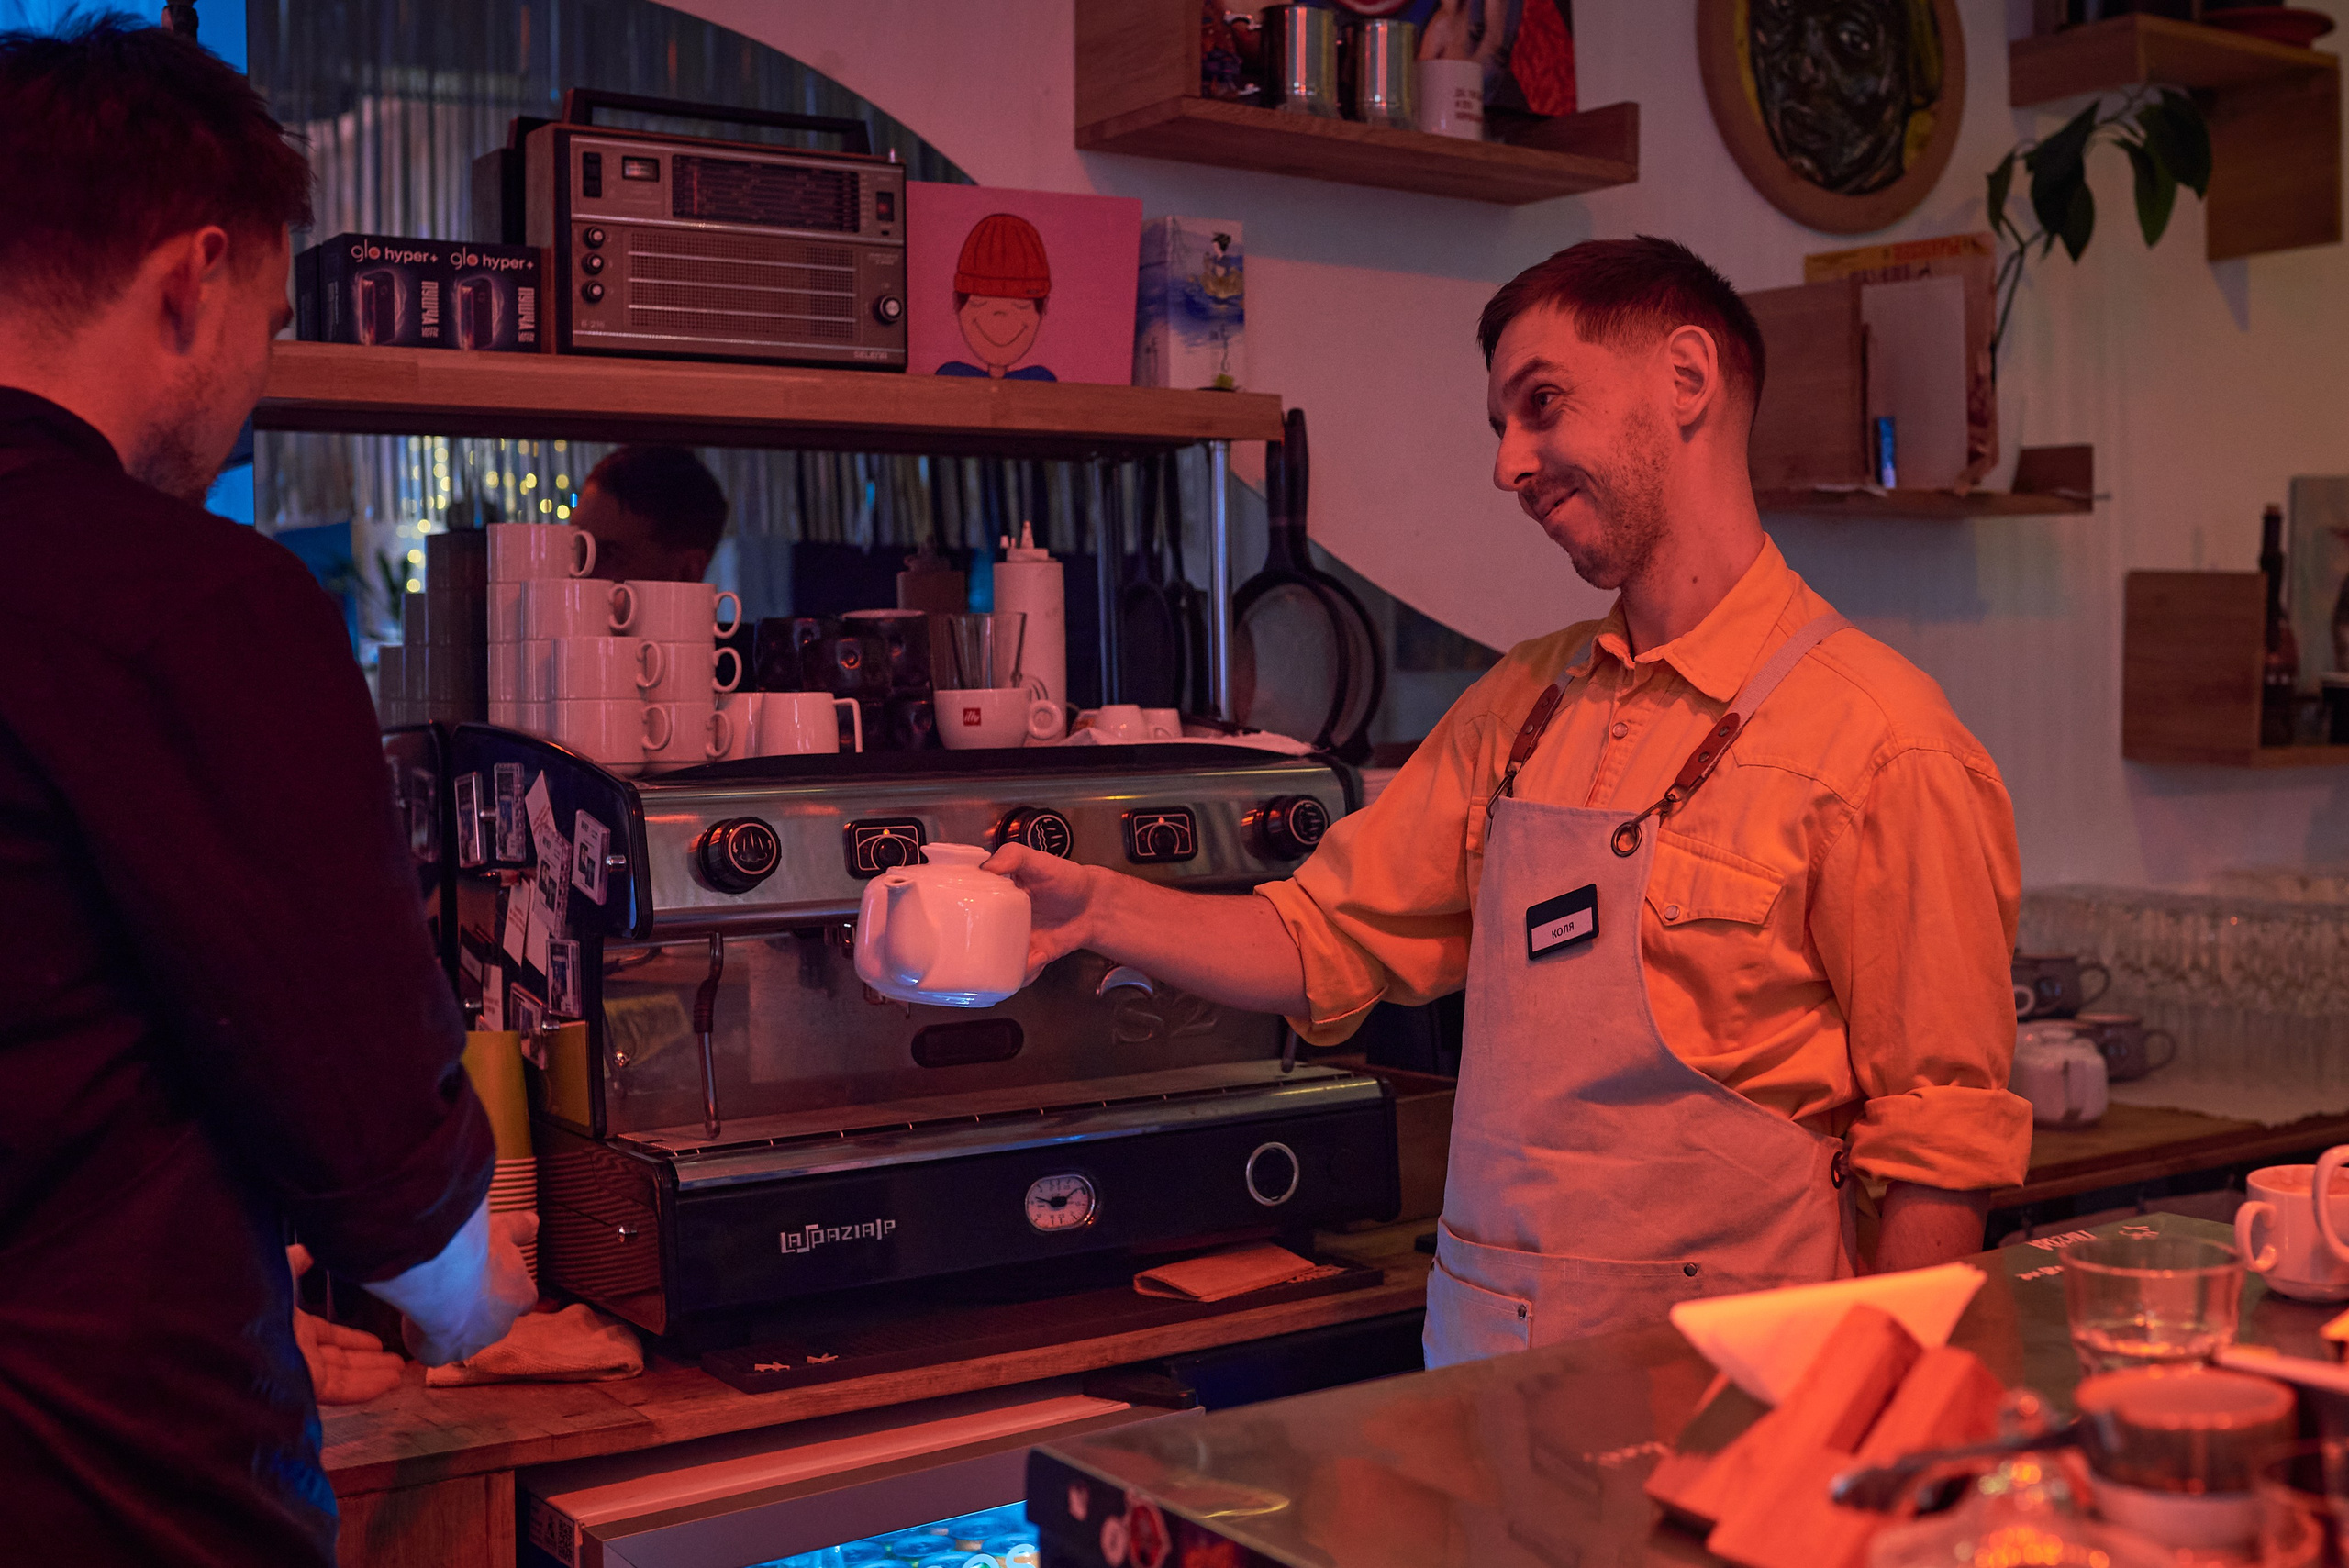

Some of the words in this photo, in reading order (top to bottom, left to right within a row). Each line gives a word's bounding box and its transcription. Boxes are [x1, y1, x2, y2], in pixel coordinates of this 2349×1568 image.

[351, 239, 381, 263] glo
[384, 247, 439, 264] hyper+
[450, 246, 479, 271] glo
[483, 253, 535, 272] hyper+
[1551, 921, 1575, 940] КОЛЯ
